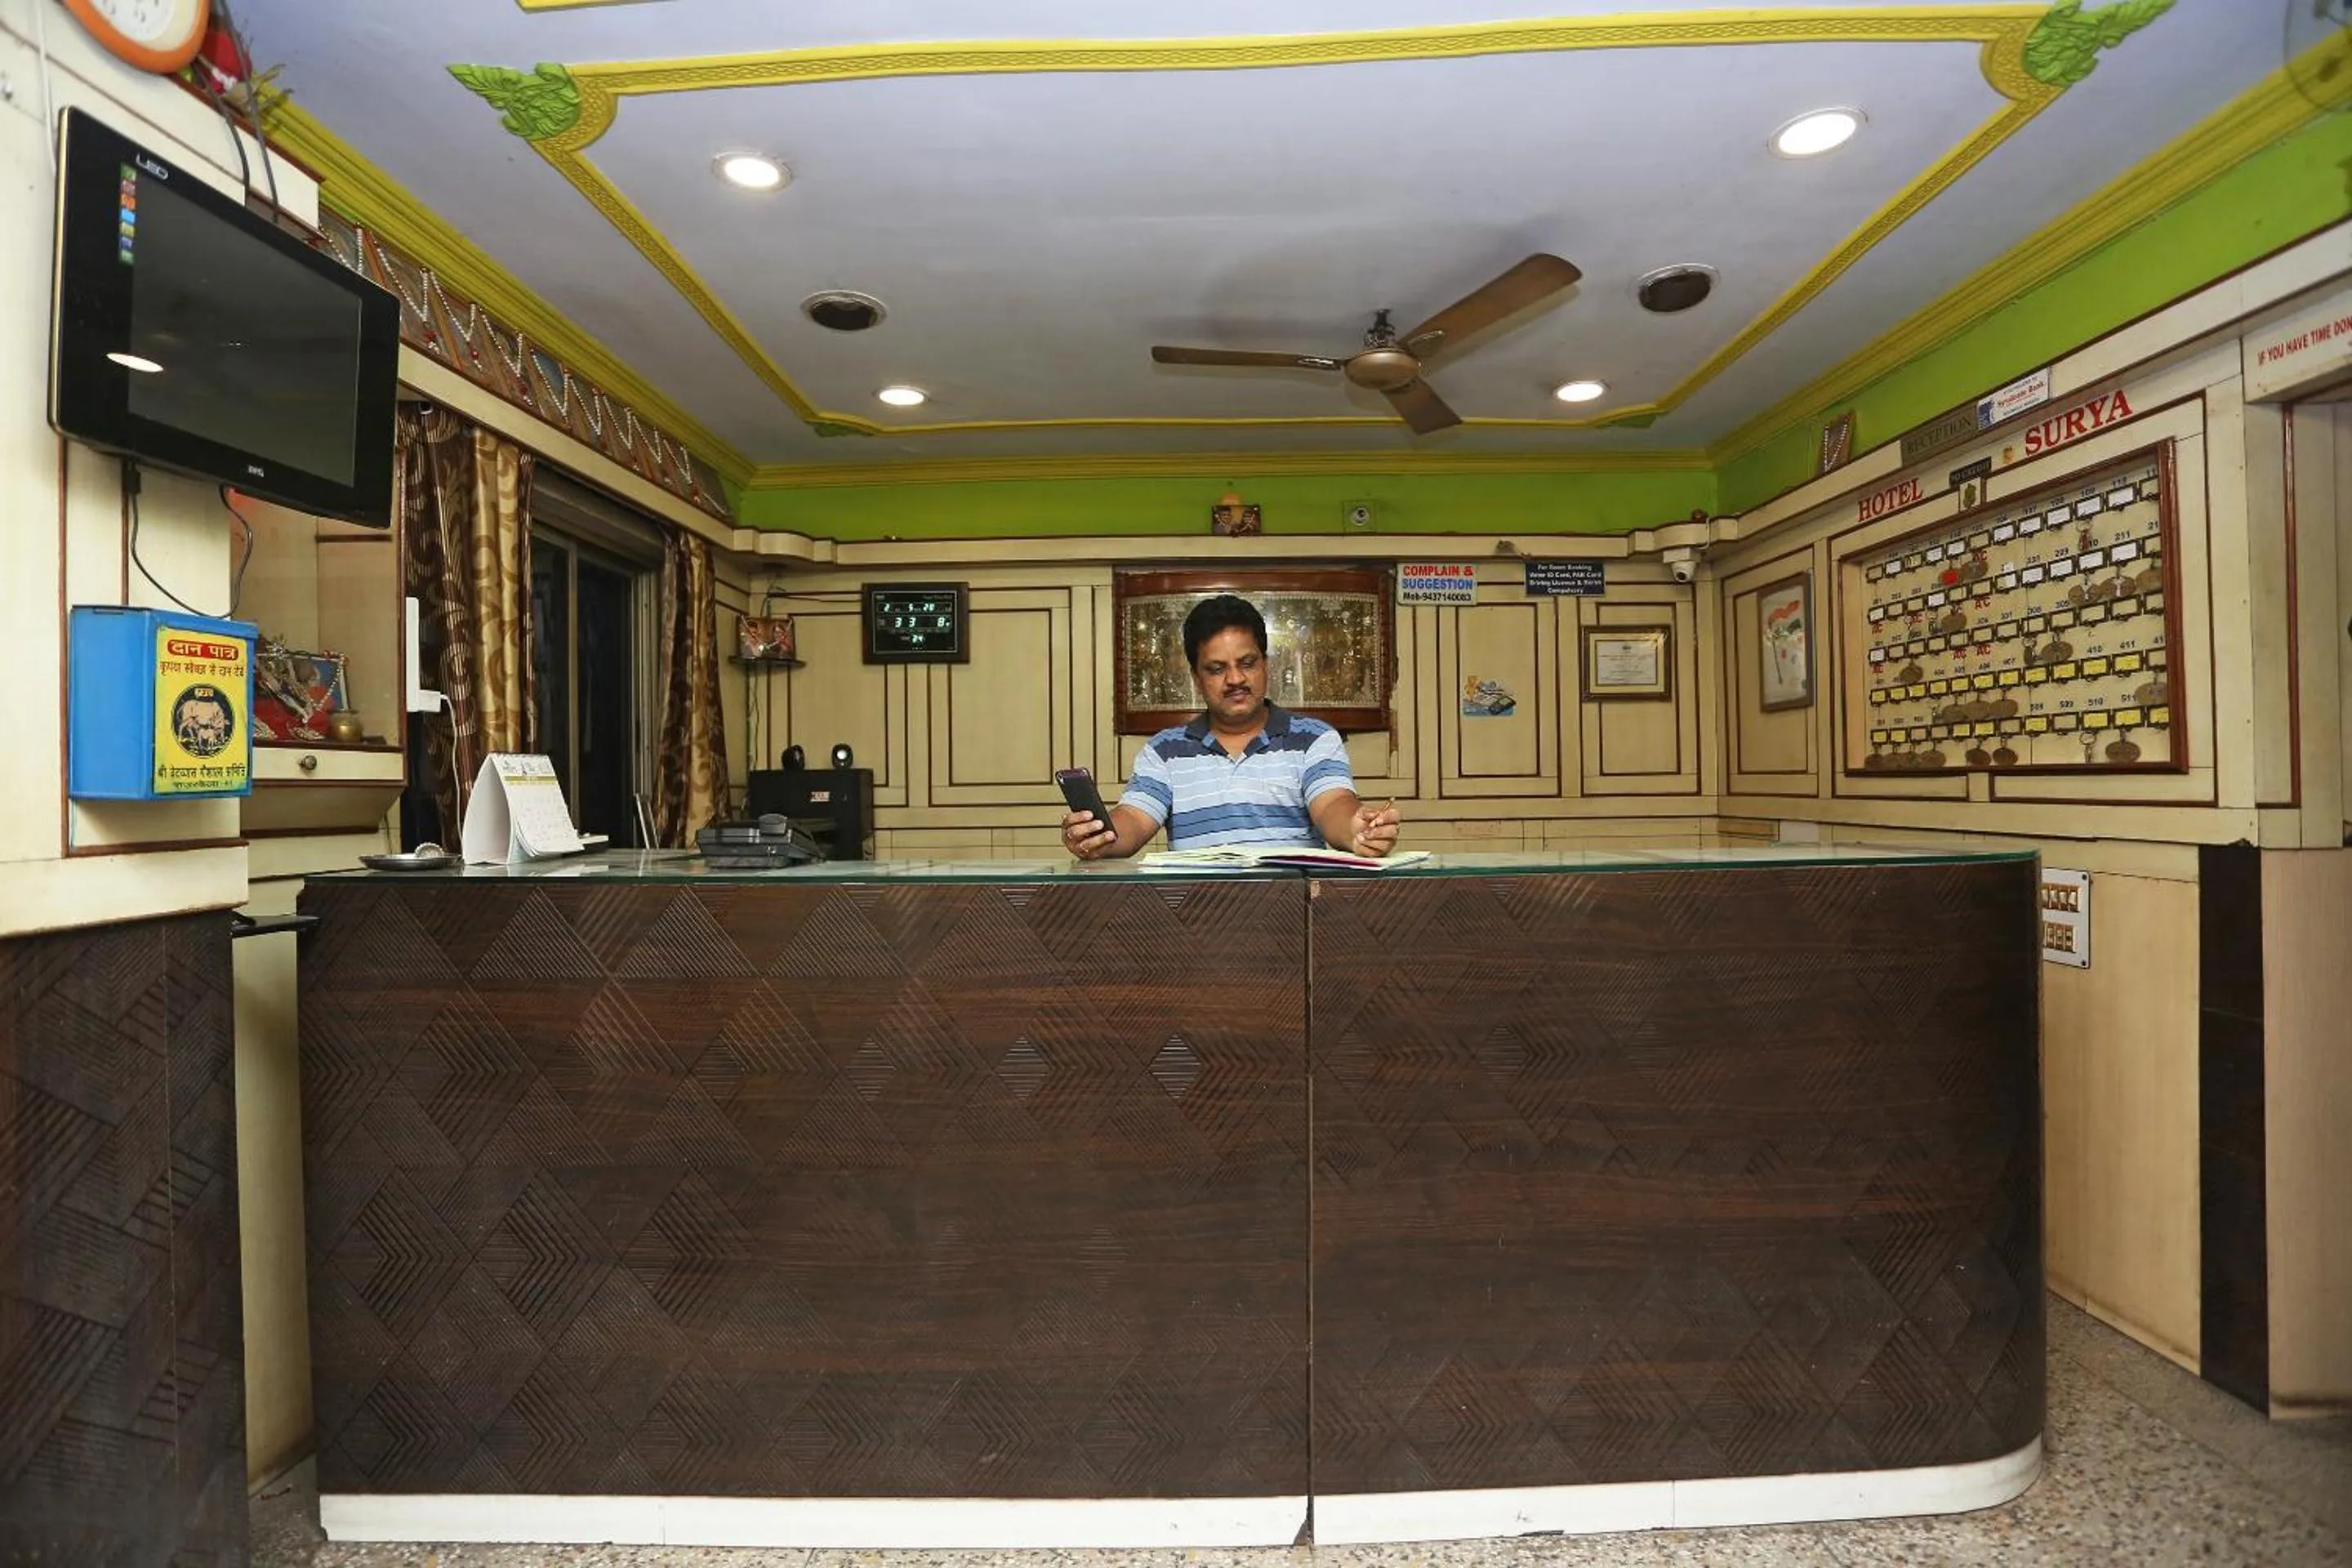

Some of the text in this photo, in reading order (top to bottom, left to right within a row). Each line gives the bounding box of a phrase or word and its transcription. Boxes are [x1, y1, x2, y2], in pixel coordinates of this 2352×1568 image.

[2257, 351, 2267, 366] IF
[2267, 343, 2284, 362] YOU
[2286, 335, 2310, 354] HAVE
[2310, 325, 2332, 346] TIME
[2025, 390, 2134, 457] SURYA
[1857, 478, 1924, 523] HOTEL
[1402, 578, 1474, 589] SUGGESTION
[1404, 566, 1473, 576] COMPLAIN &
[171, 641, 236, 660] दान पात्र
